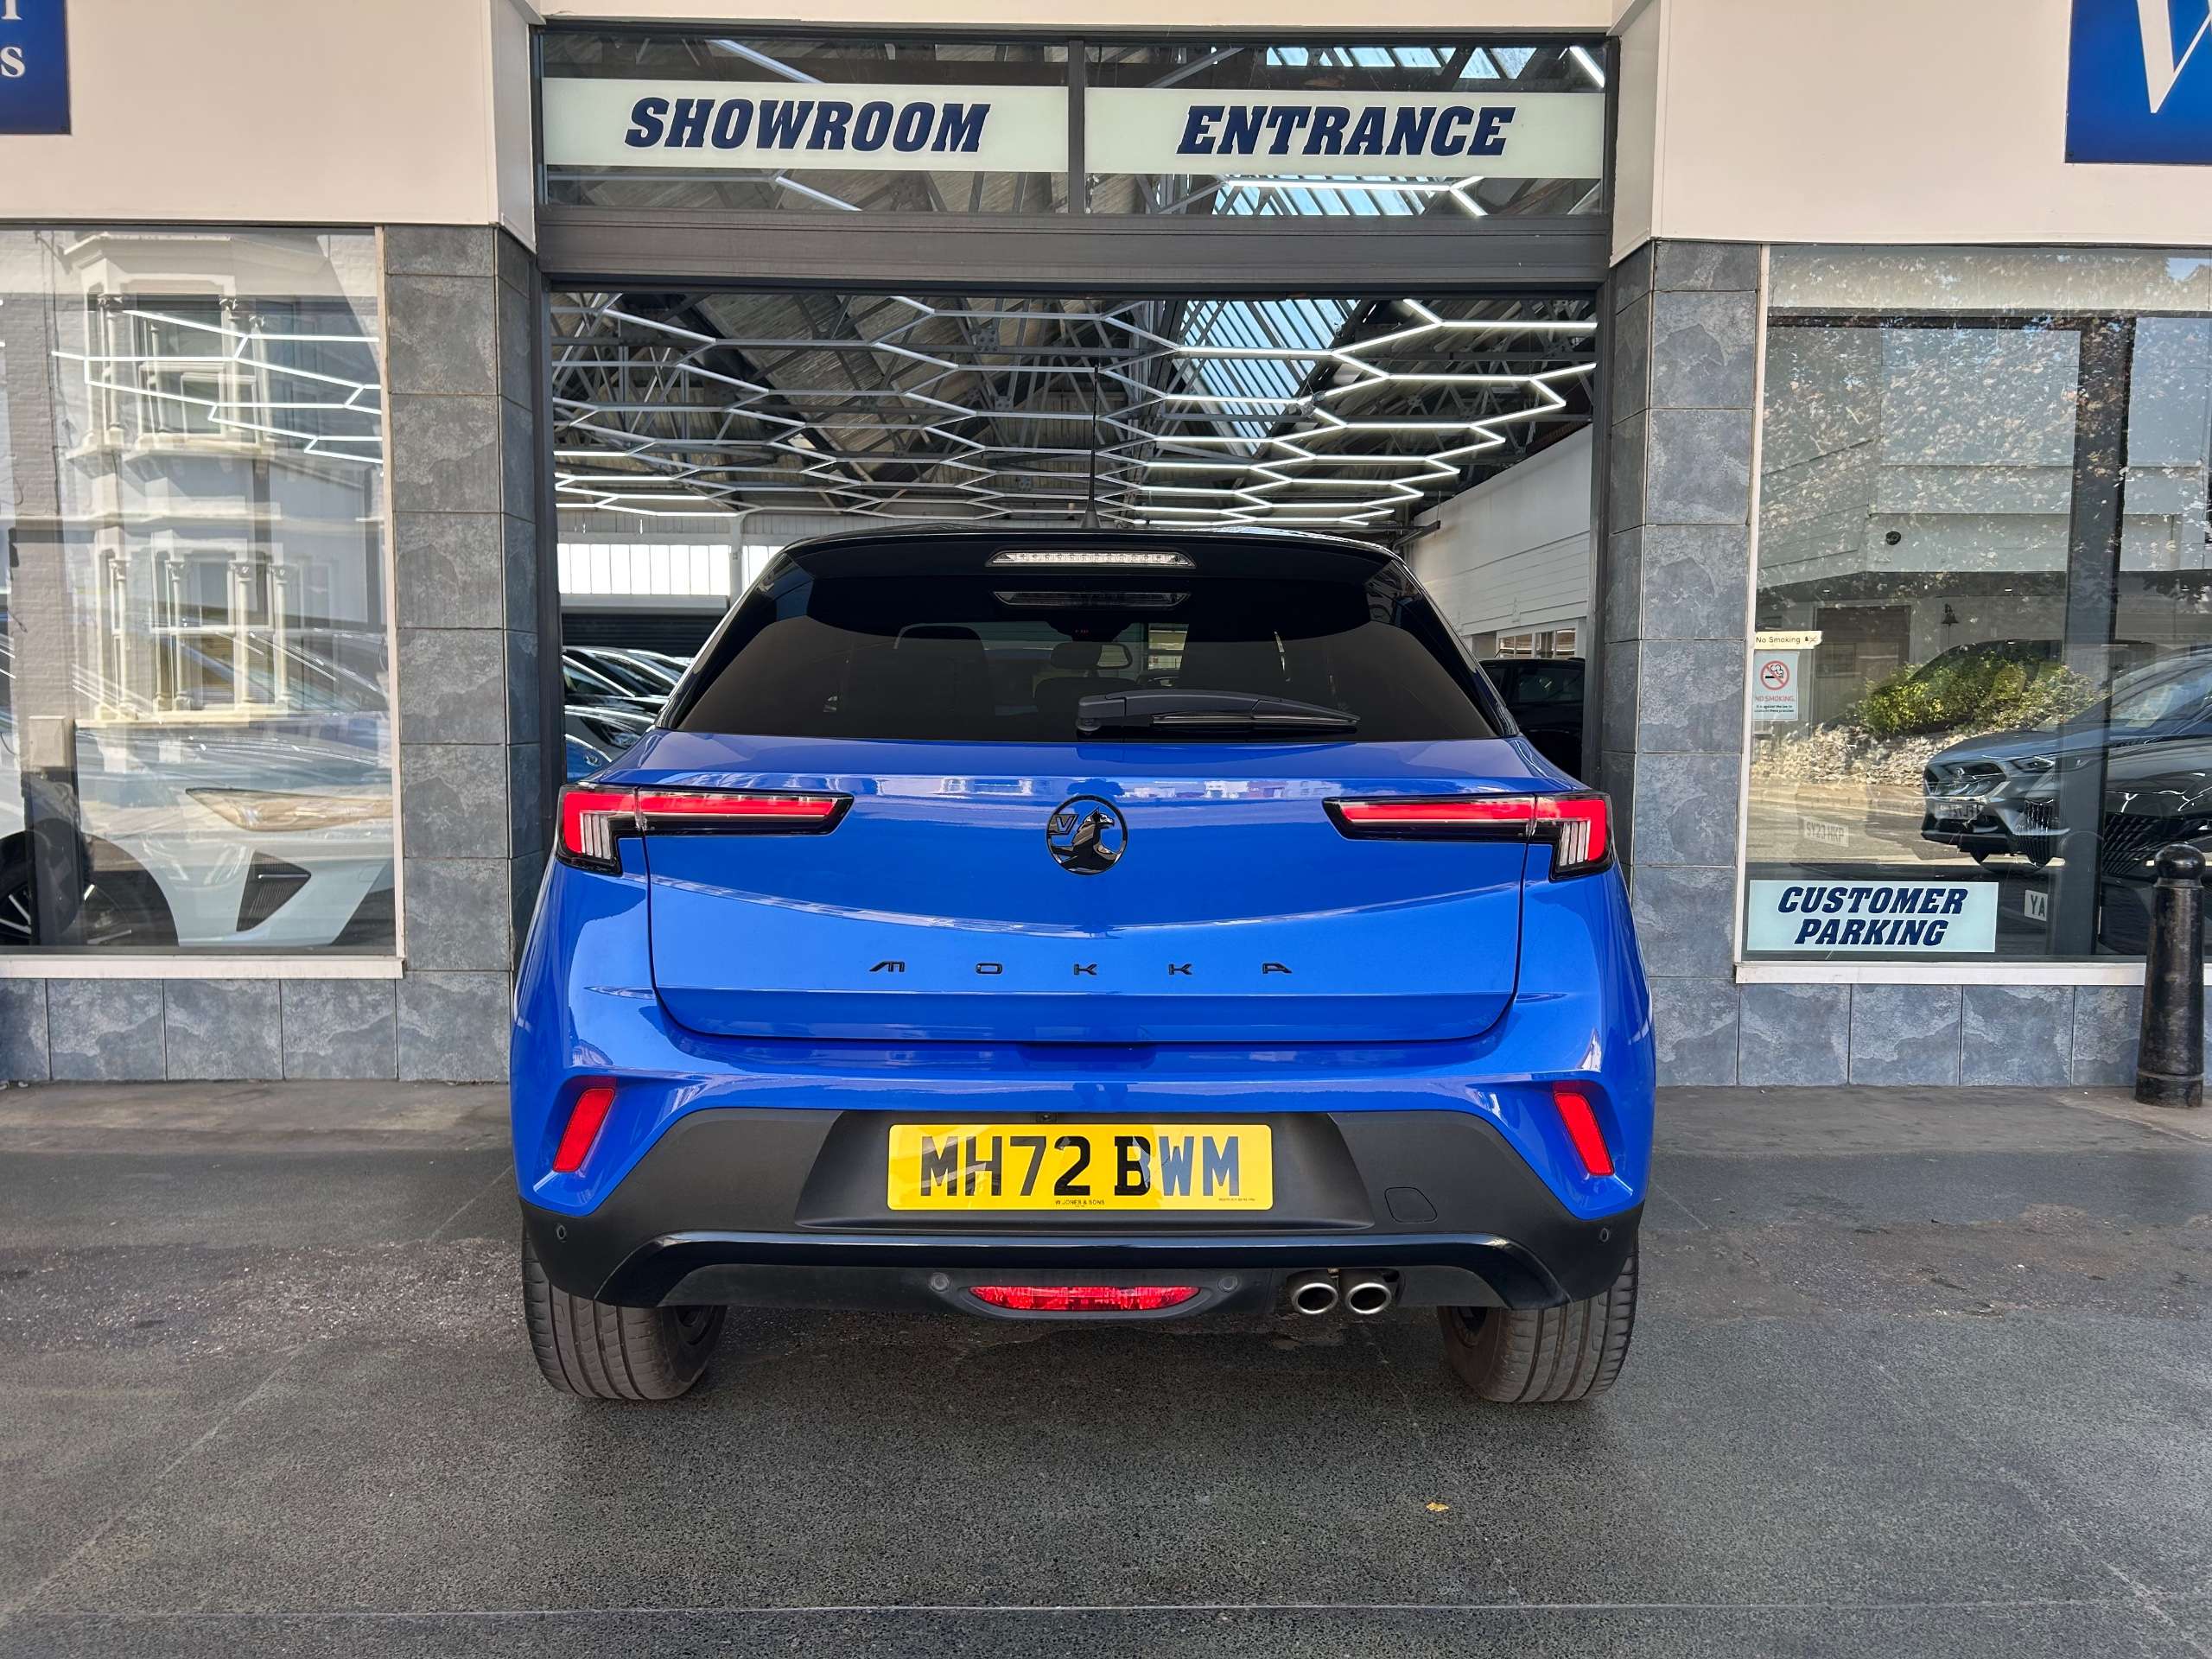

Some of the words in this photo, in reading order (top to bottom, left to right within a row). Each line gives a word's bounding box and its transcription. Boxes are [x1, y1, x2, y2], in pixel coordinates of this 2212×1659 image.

[624, 97, 991, 153] SHOWROOM
[1176, 105, 1516, 157] ENTRANCE
[1769, 636, 1801, 645] Smoking
[1777, 887, 1968, 914] CUSTOMER
[1794, 918, 1949, 945] PARKING
[868, 961, 1293, 976] MOKKA
[920, 1135, 1091, 1197] MH72
[1114, 1135, 1240, 1197] BWM
